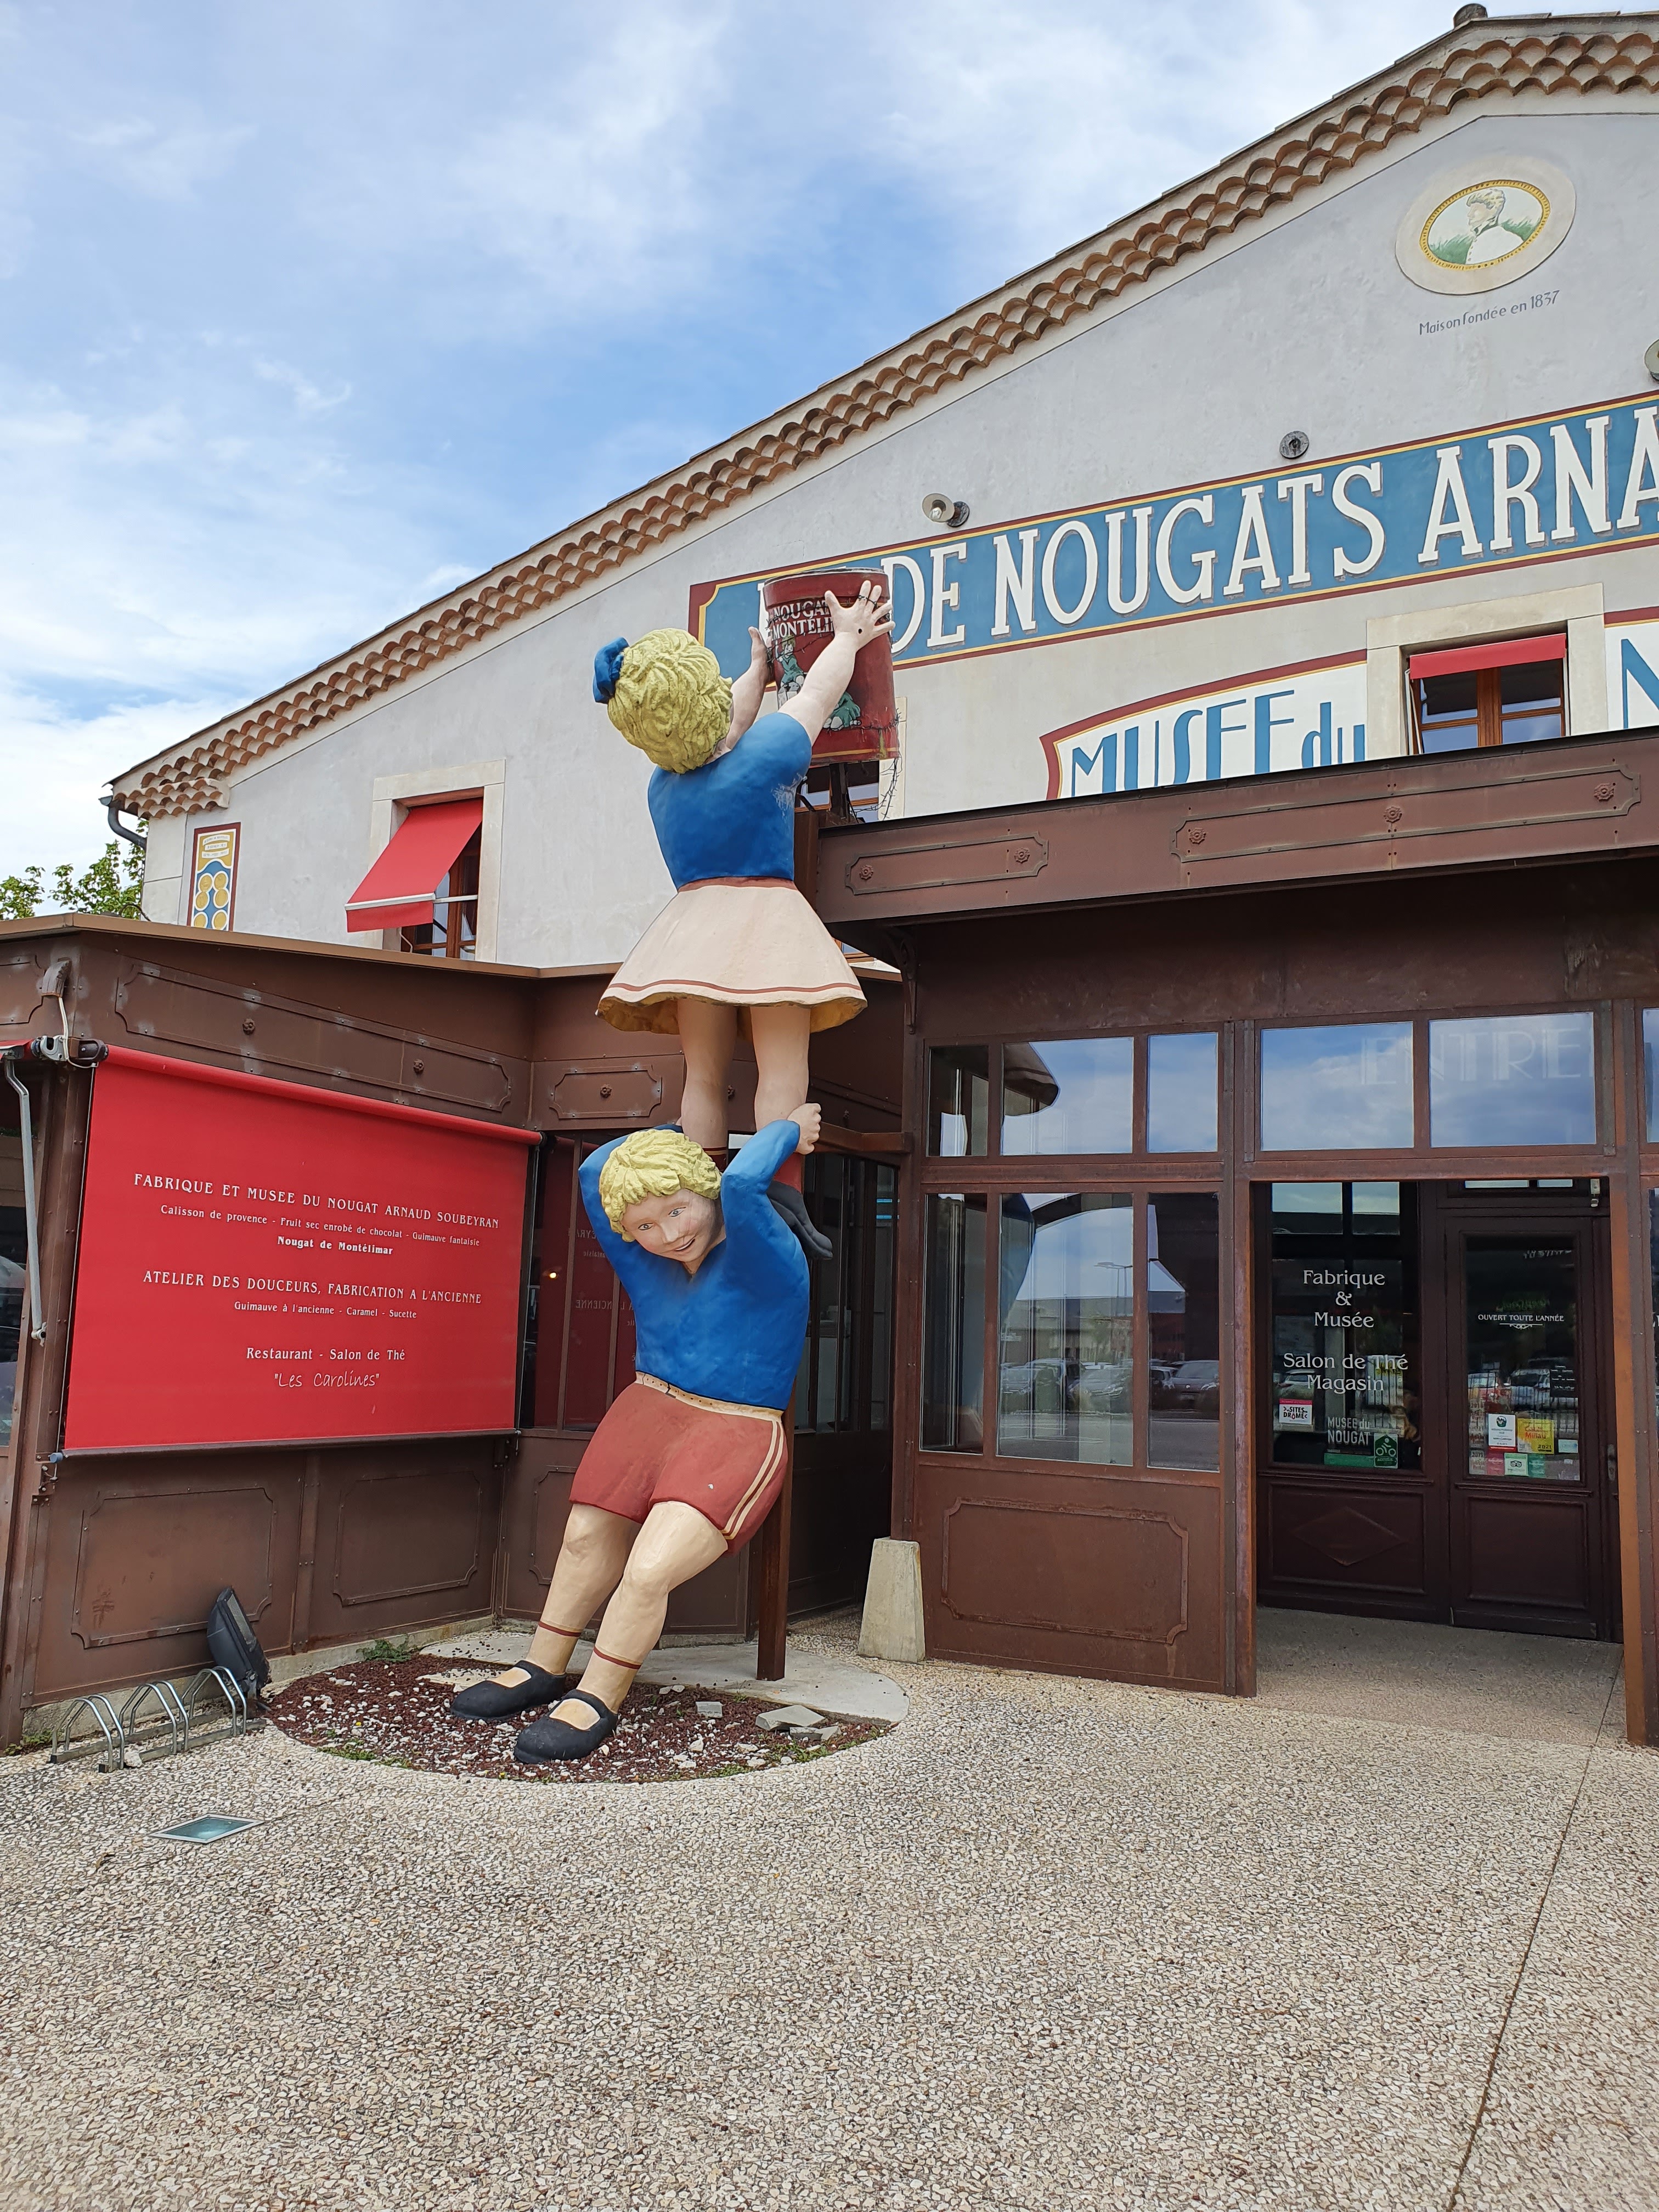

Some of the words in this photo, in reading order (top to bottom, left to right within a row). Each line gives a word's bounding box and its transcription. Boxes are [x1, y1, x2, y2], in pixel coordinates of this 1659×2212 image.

[1419, 318, 1460, 335] Maison
[1463, 306, 1507, 325] fondée
[1510, 303, 1527, 314] en
[1530, 290, 1560, 309] 1837
[881, 542, 968, 654] DE
[991, 461, 1386, 636] NOUGATS
[1301, 702, 1365, 768] du
[1361, 1028, 1593, 1085] ENTRE
[134, 1173, 213, 1194] FABRIQUE
[222, 1184, 240, 1197] ET
[247, 1187, 295, 1204] MUSEE
[303, 1194, 320, 1206] DU
[327, 1197, 379, 1214] NOUGAT
[384, 1205, 431, 1220] ARNAUD
[437, 1211, 499, 1228] SOUBEYRAN
[160, 1205, 204, 1218] Calisson
[210, 1210, 222, 1220] de
[227, 1213, 267, 1224] provence
[280, 1217, 301, 1227] Fruit
[324, 1223, 353, 1233] enrobé
[369, 1228, 402, 1238] chocolat
[412, 1232, 446, 1243] Guimauve
[449, 1235, 480, 1246] fantaisie
[277, 1235, 314, 1249] Nougat
[319, 1240, 332, 1249] de
[338, 1242, 393, 1255] Montélimar
[143, 1270, 204, 1286] ATELIER
[212, 1275, 240, 1288] DES
[247, 1278, 321, 1295] DOUCEURS,
[328, 1283, 404, 1299] FABRICATION
[409, 1289, 416, 1300] A
[422, 1290, 481, 1304] L'ANCIENNE
[1303, 1269, 1385, 1289] Fabrique
[1335, 1291, 1352, 1306] &
[234, 1301, 278, 1312] Guimauve
[282, 1304, 287, 1312] à
[292, 1304, 335, 1314] l'ancienne
[346, 1307, 378, 1317] Caramel
[389, 1309, 417, 1318] Sucette
[1314, 1311, 1374, 1328] Musée
[246, 1347, 313, 1359] Restaurant
[330, 1348, 361, 1360] Salon
[367, 1349, 380, 1360] de
[387, 1349, 405, 1360] Thé
[1283, 1353, 1335, 1368] Salon
[1342, 1353, 1366, 1369] de
[1373, 1353, 1409, 1370] Thé
[274, 1373, 302, 1388] "Les
[1307, 1374, 1384, 1395] Magasin
[1328, 1416, 1358, 1429] MUSEE
[1359, 1418, 1370, 1429] du
[1328, 1430, 1369, 1446] NOUGAT
